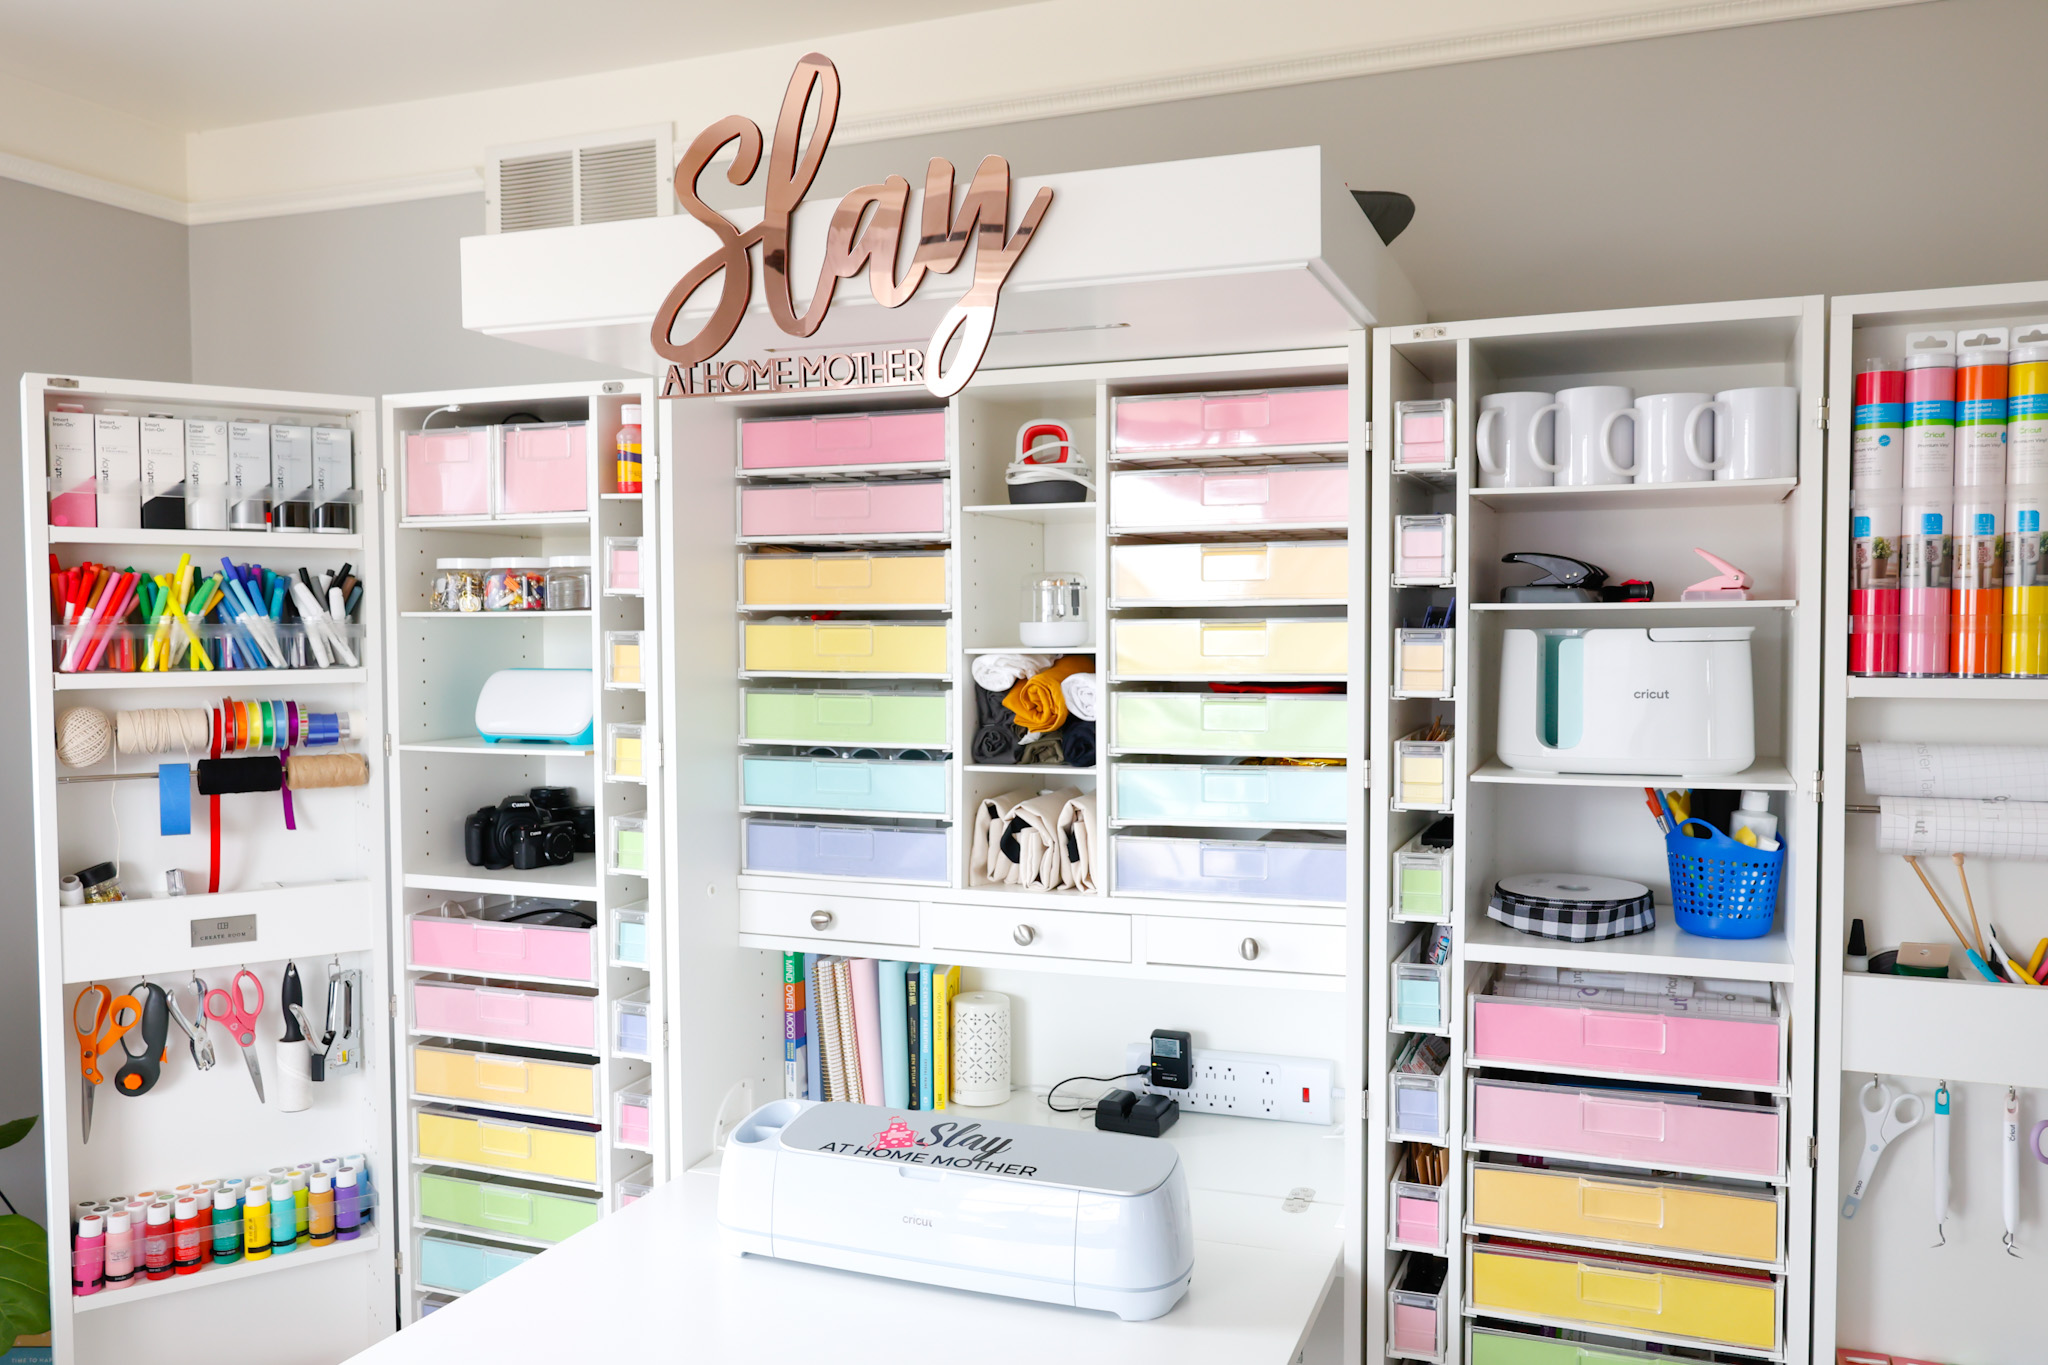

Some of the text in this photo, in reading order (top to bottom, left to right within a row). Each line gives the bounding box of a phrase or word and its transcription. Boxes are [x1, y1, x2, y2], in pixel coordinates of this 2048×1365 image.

[650, 52, 1054, 398] Slay
[661, 349, 925, 396] AT HOME MOTHER
[1976, 431, 1998, 439] Cricut
[1633, 689, 1670, 700] cricut
[1921, 775, 1936, 798] Tap
[785, 959, 795, 1039] MIND OVER MOOD
[818, 1141, 1038, 1177] AT HOME MOTHER
[916, 1121, 1014, 1162] Slay
[902, 1213, 933, 1228] cricut
